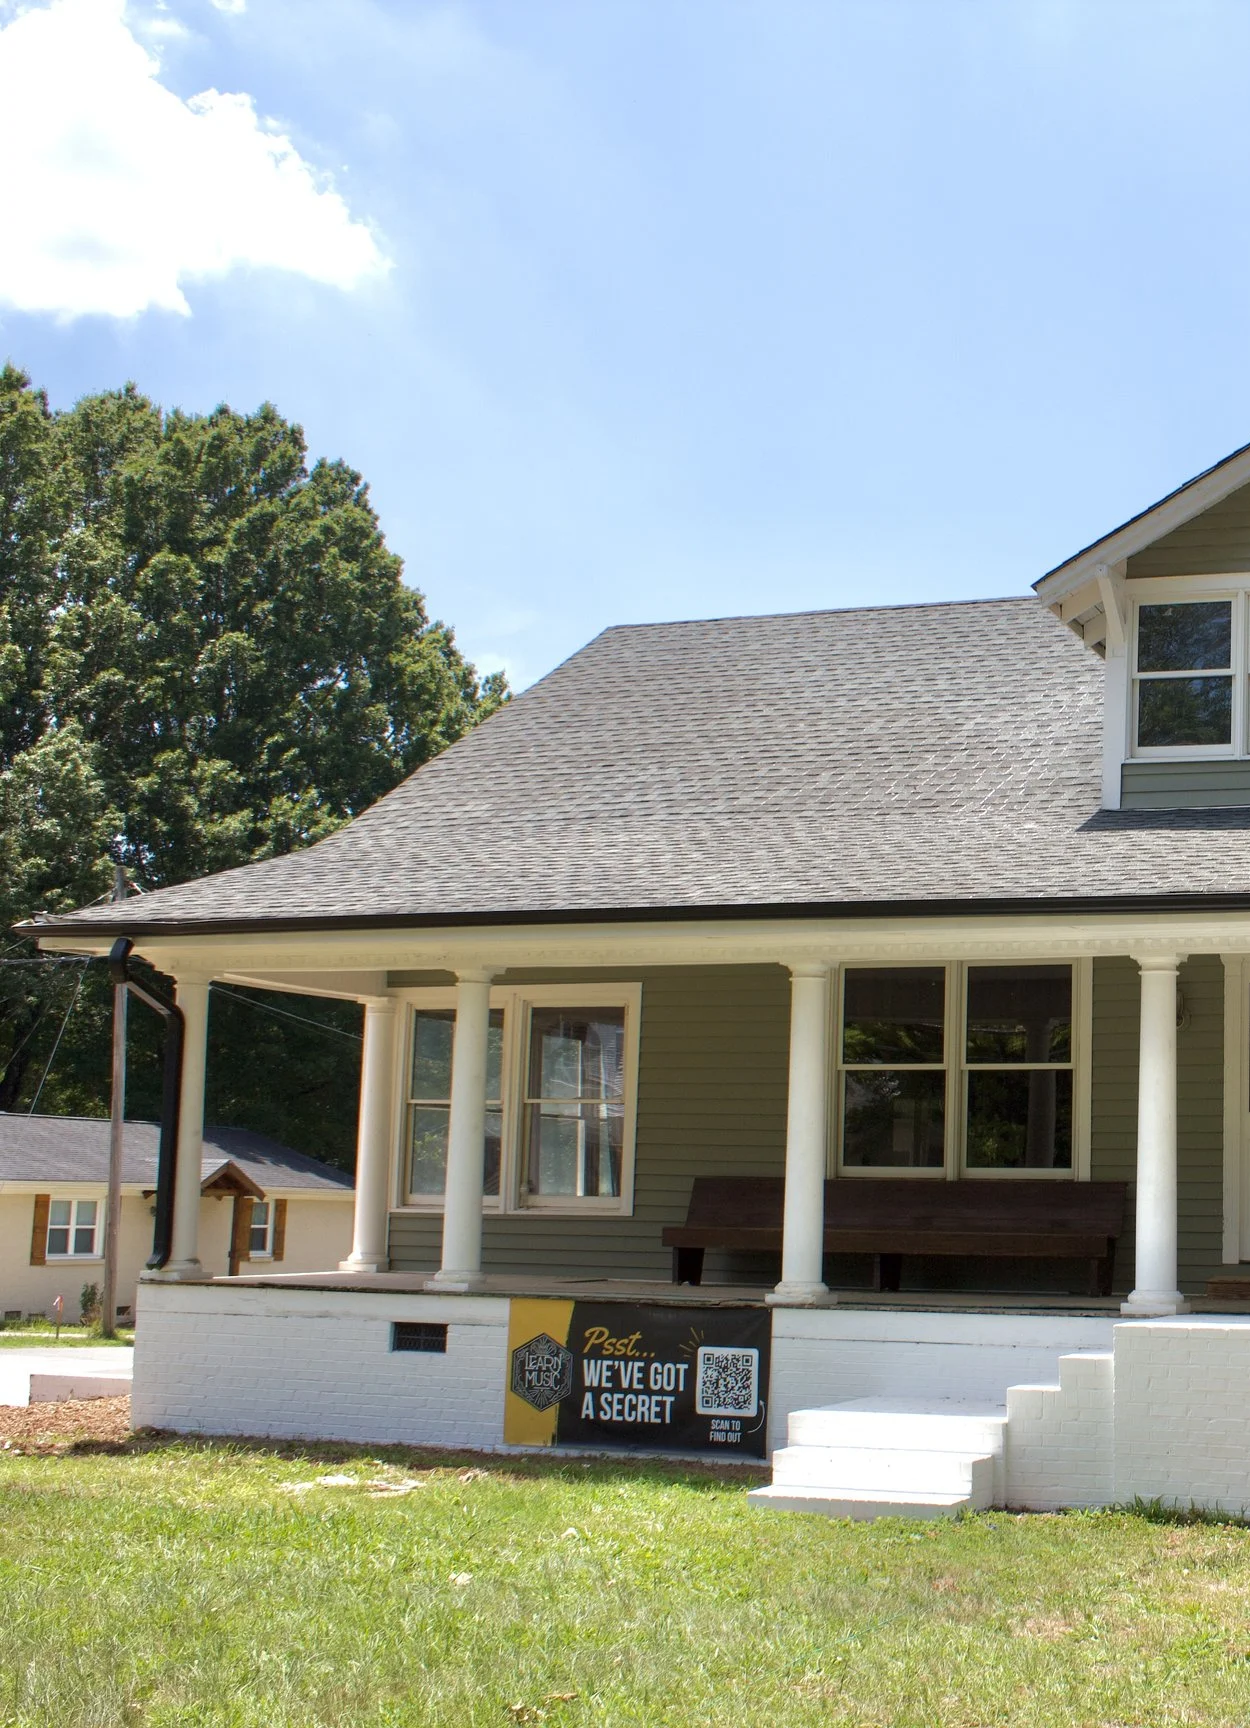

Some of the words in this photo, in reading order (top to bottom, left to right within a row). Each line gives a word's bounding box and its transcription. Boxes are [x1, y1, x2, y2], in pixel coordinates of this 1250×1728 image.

[583, 1326, 655, 1357] Psst...
[525, 1352, 562, 1375] LEARN
[583, 1359, 645, 1388] WE’VE
[650, 1363, 688, 1391] GOT
[525, 1371, 560, 1390] MUSIC
[581, 1391, 595, 1419] A
[600, 1393, 675, 1424] SECRET
[711, 1419, 729, 1430] SCAN
[732, 1420, 741, 1431] TO
[709, 1431, 726, 1442] FIND
[727, 1432, 741, 1443] OUT
